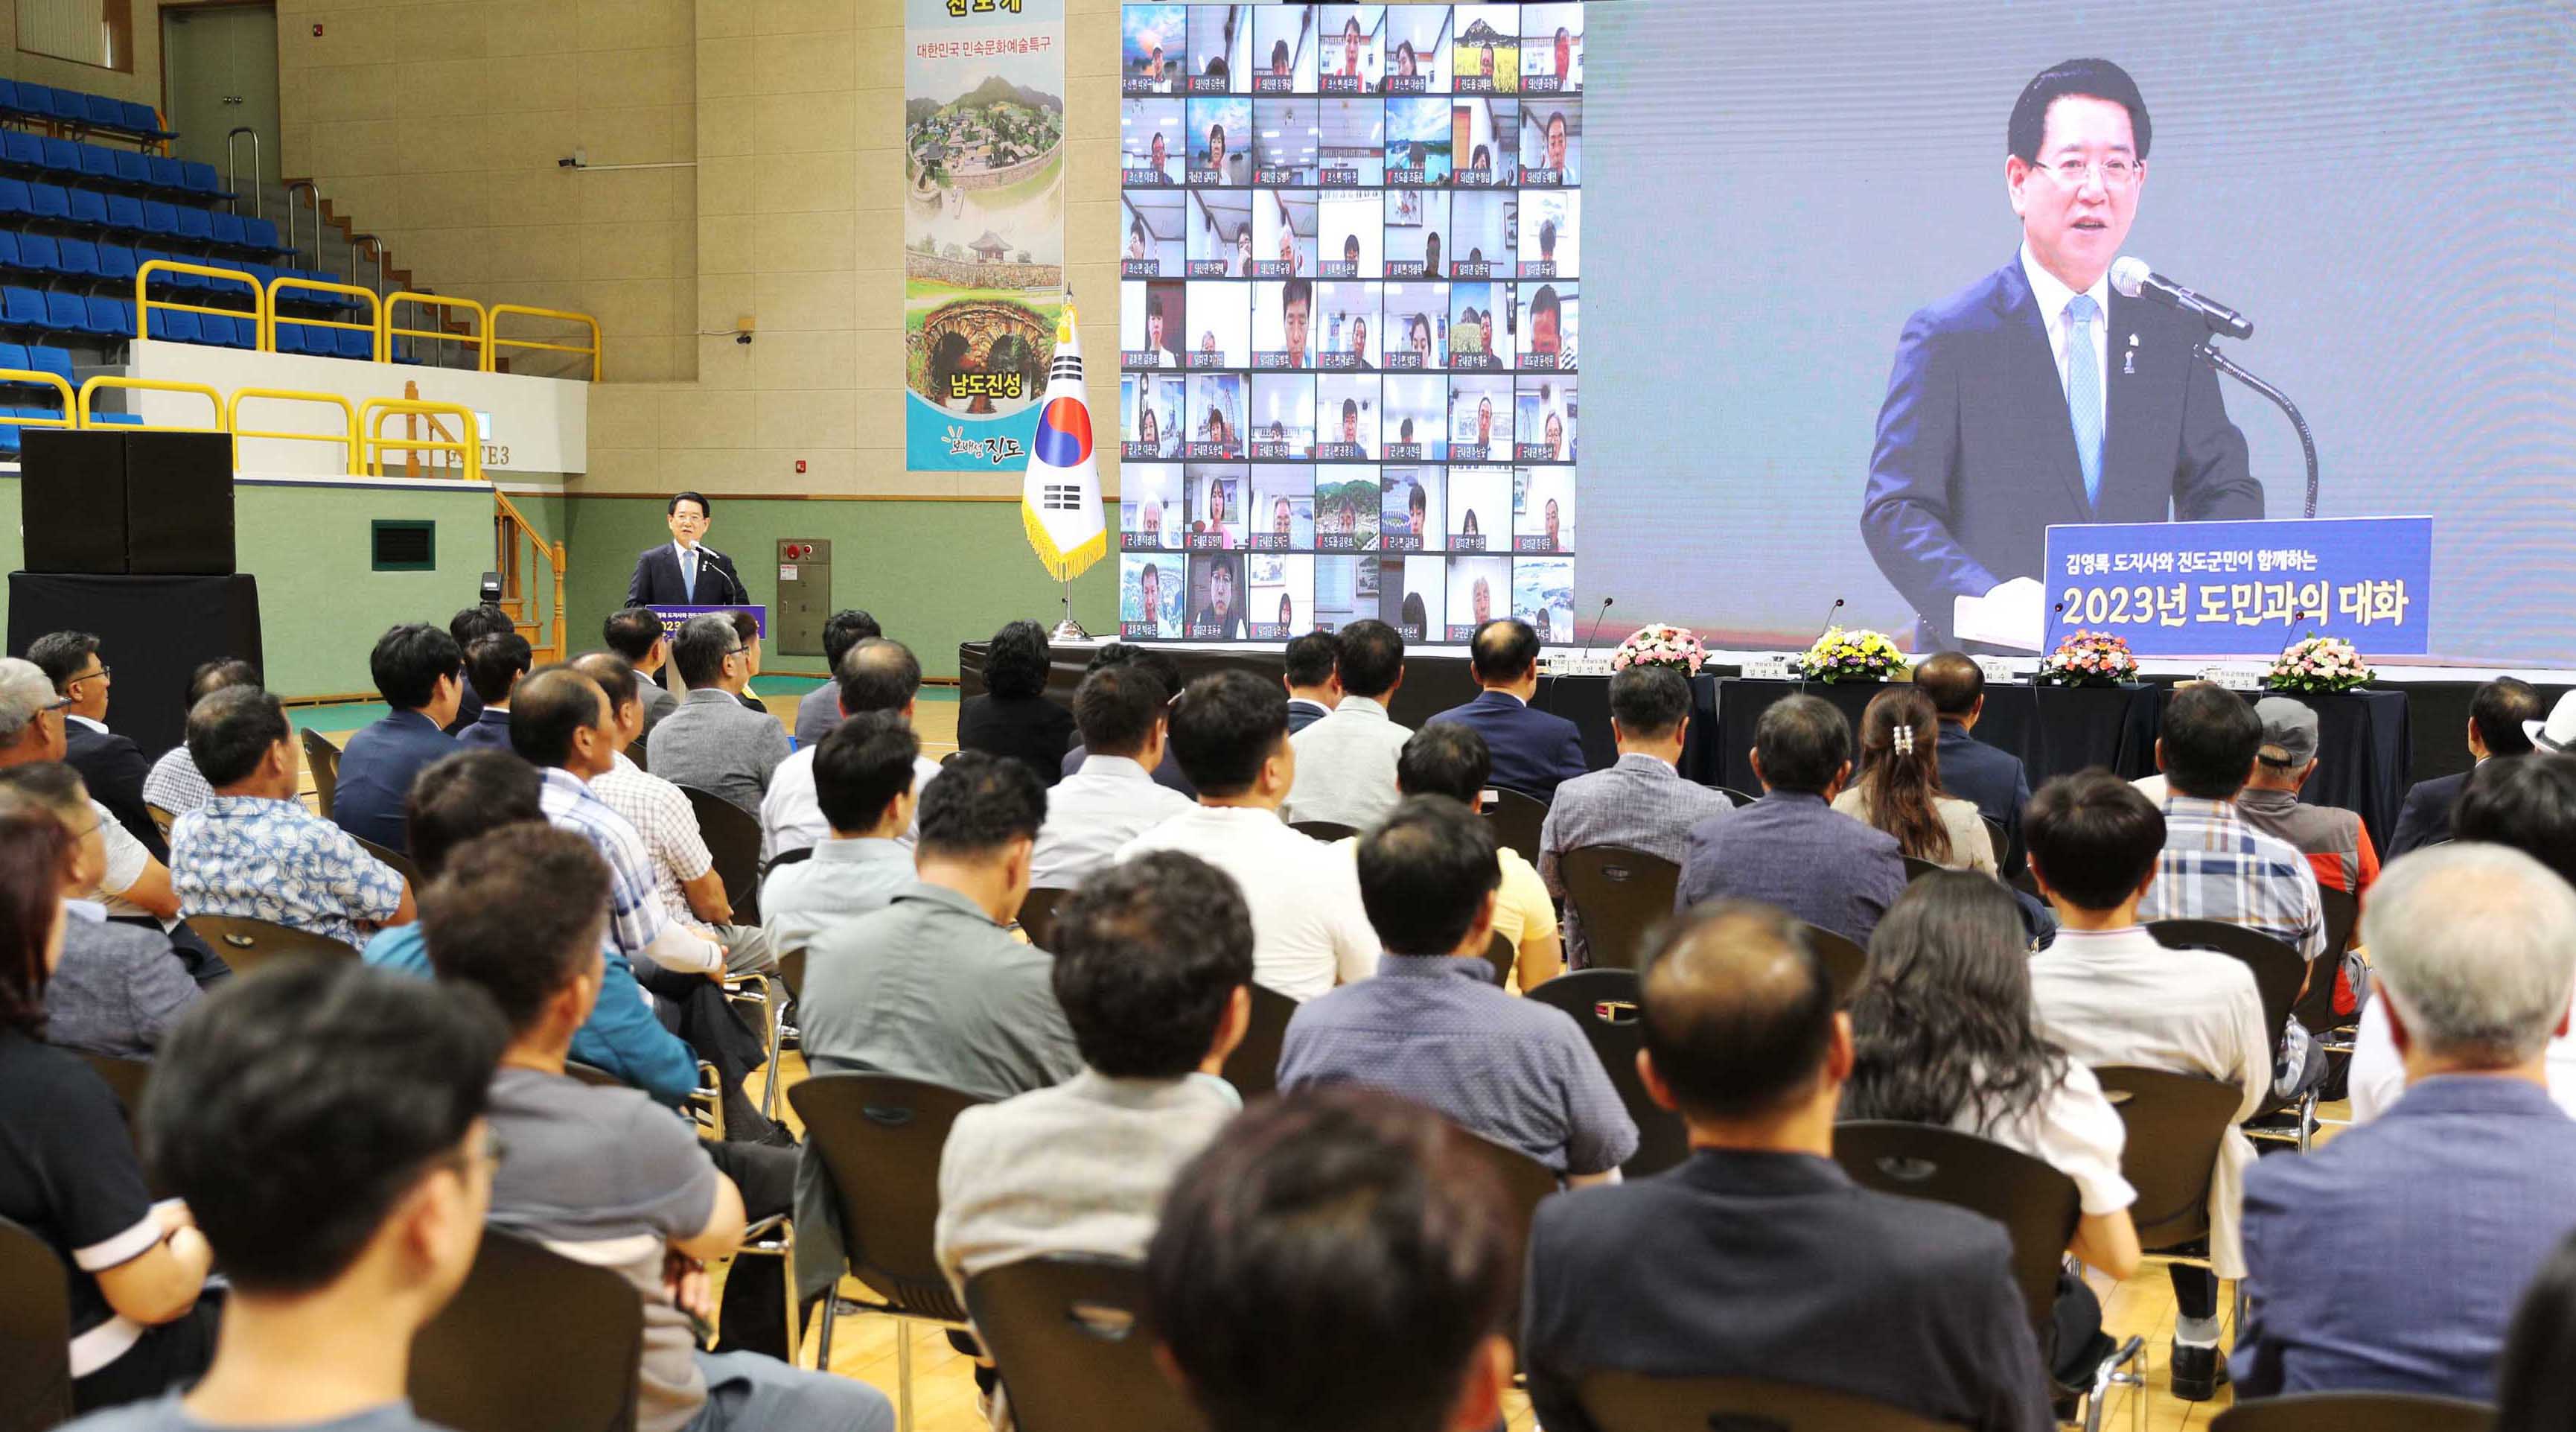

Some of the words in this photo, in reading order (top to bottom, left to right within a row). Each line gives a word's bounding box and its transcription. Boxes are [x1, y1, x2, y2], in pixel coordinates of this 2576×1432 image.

[917, 42, 959, 58] 대한민국
[963, 36, 1051, 57] 민속문화예술특구
[951, 373, 1022, 397] 남도진성
[985, 437, 1024, 463] 진도
[2066, 553, 2110, 575] 김영록
[2113, 552, 2174, 573] 도지사와
[2177, 550, 2253, 573] 진도군민이
[2257, 549, 2318, 572] 함께하는
[2062, 582, 2187, 627] 2023년
[2196, 579, 2330, 626] 도민과의
[2338, 579, 2410, 626] 대화
